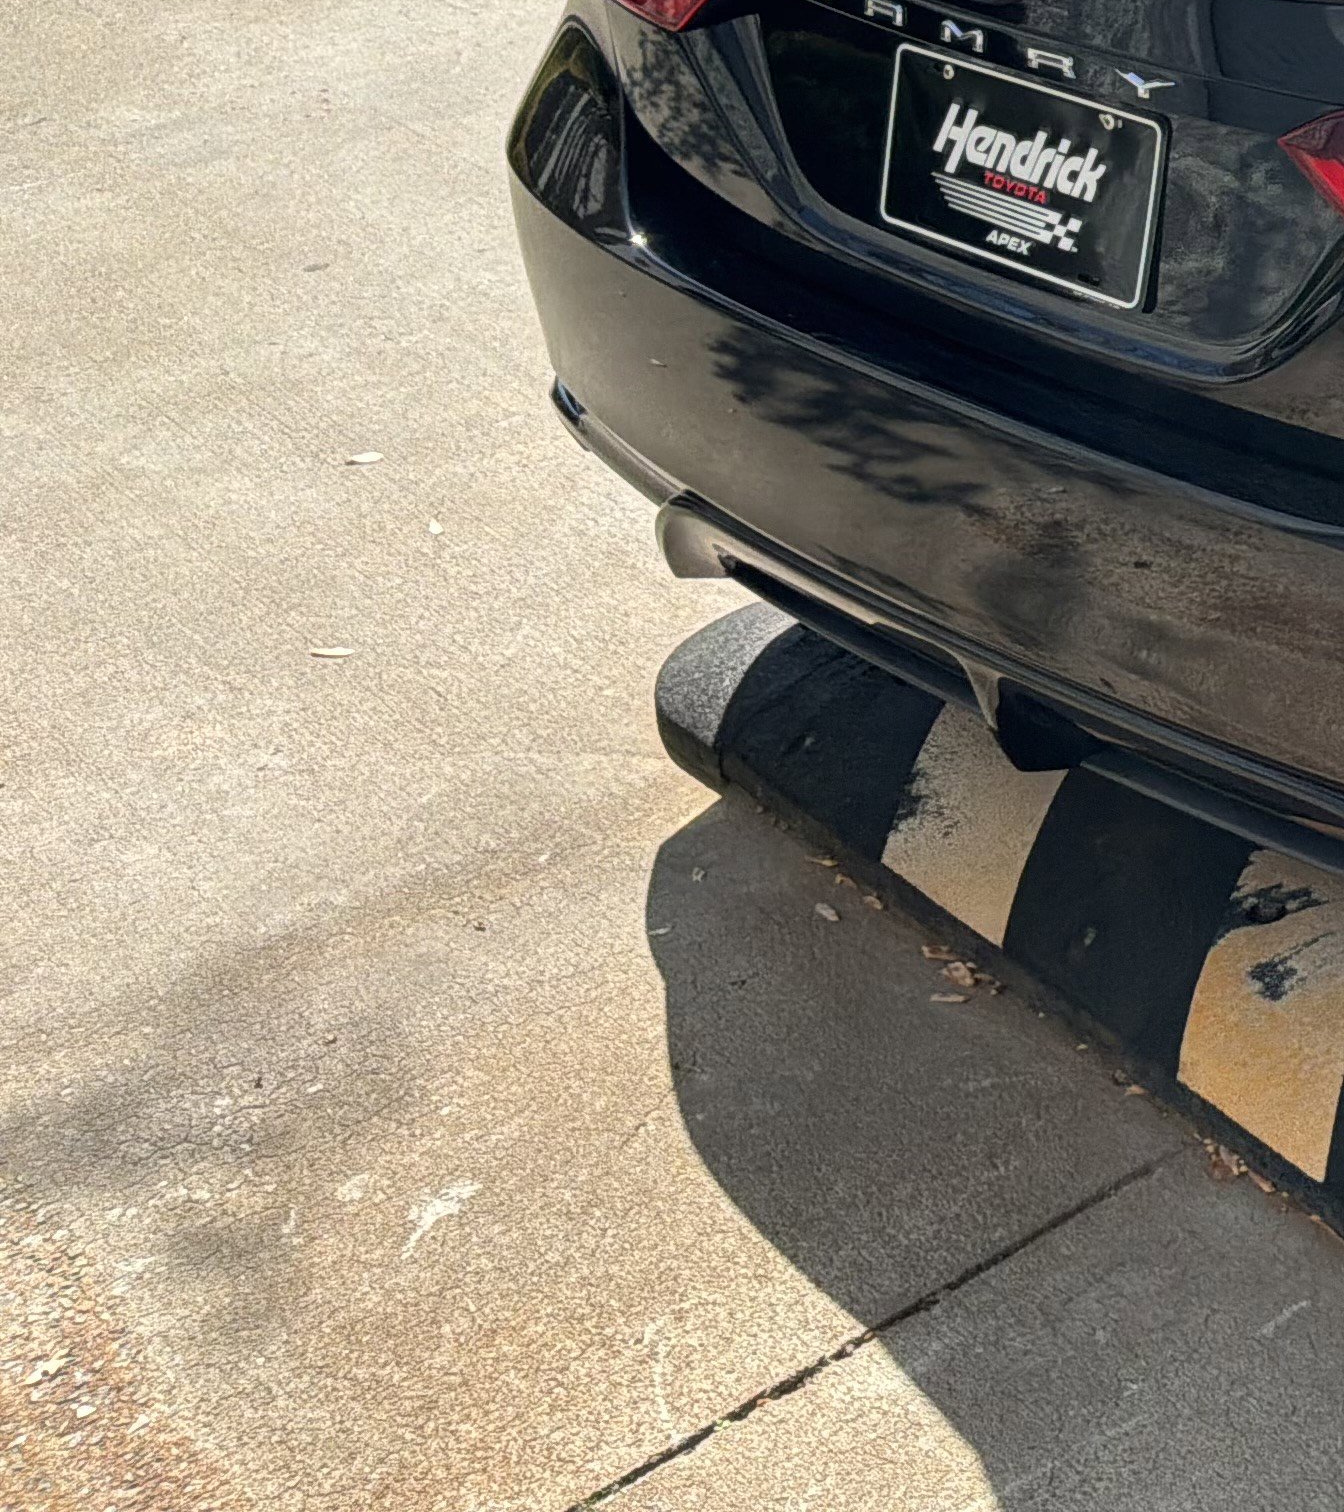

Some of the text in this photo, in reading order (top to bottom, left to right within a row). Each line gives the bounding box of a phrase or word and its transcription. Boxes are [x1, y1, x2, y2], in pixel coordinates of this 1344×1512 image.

[933, 102, 1107, 203] Hendrick
[984, 171, 1048, 205] TOYOTA
[985, 230, 1033, 256] APEX
